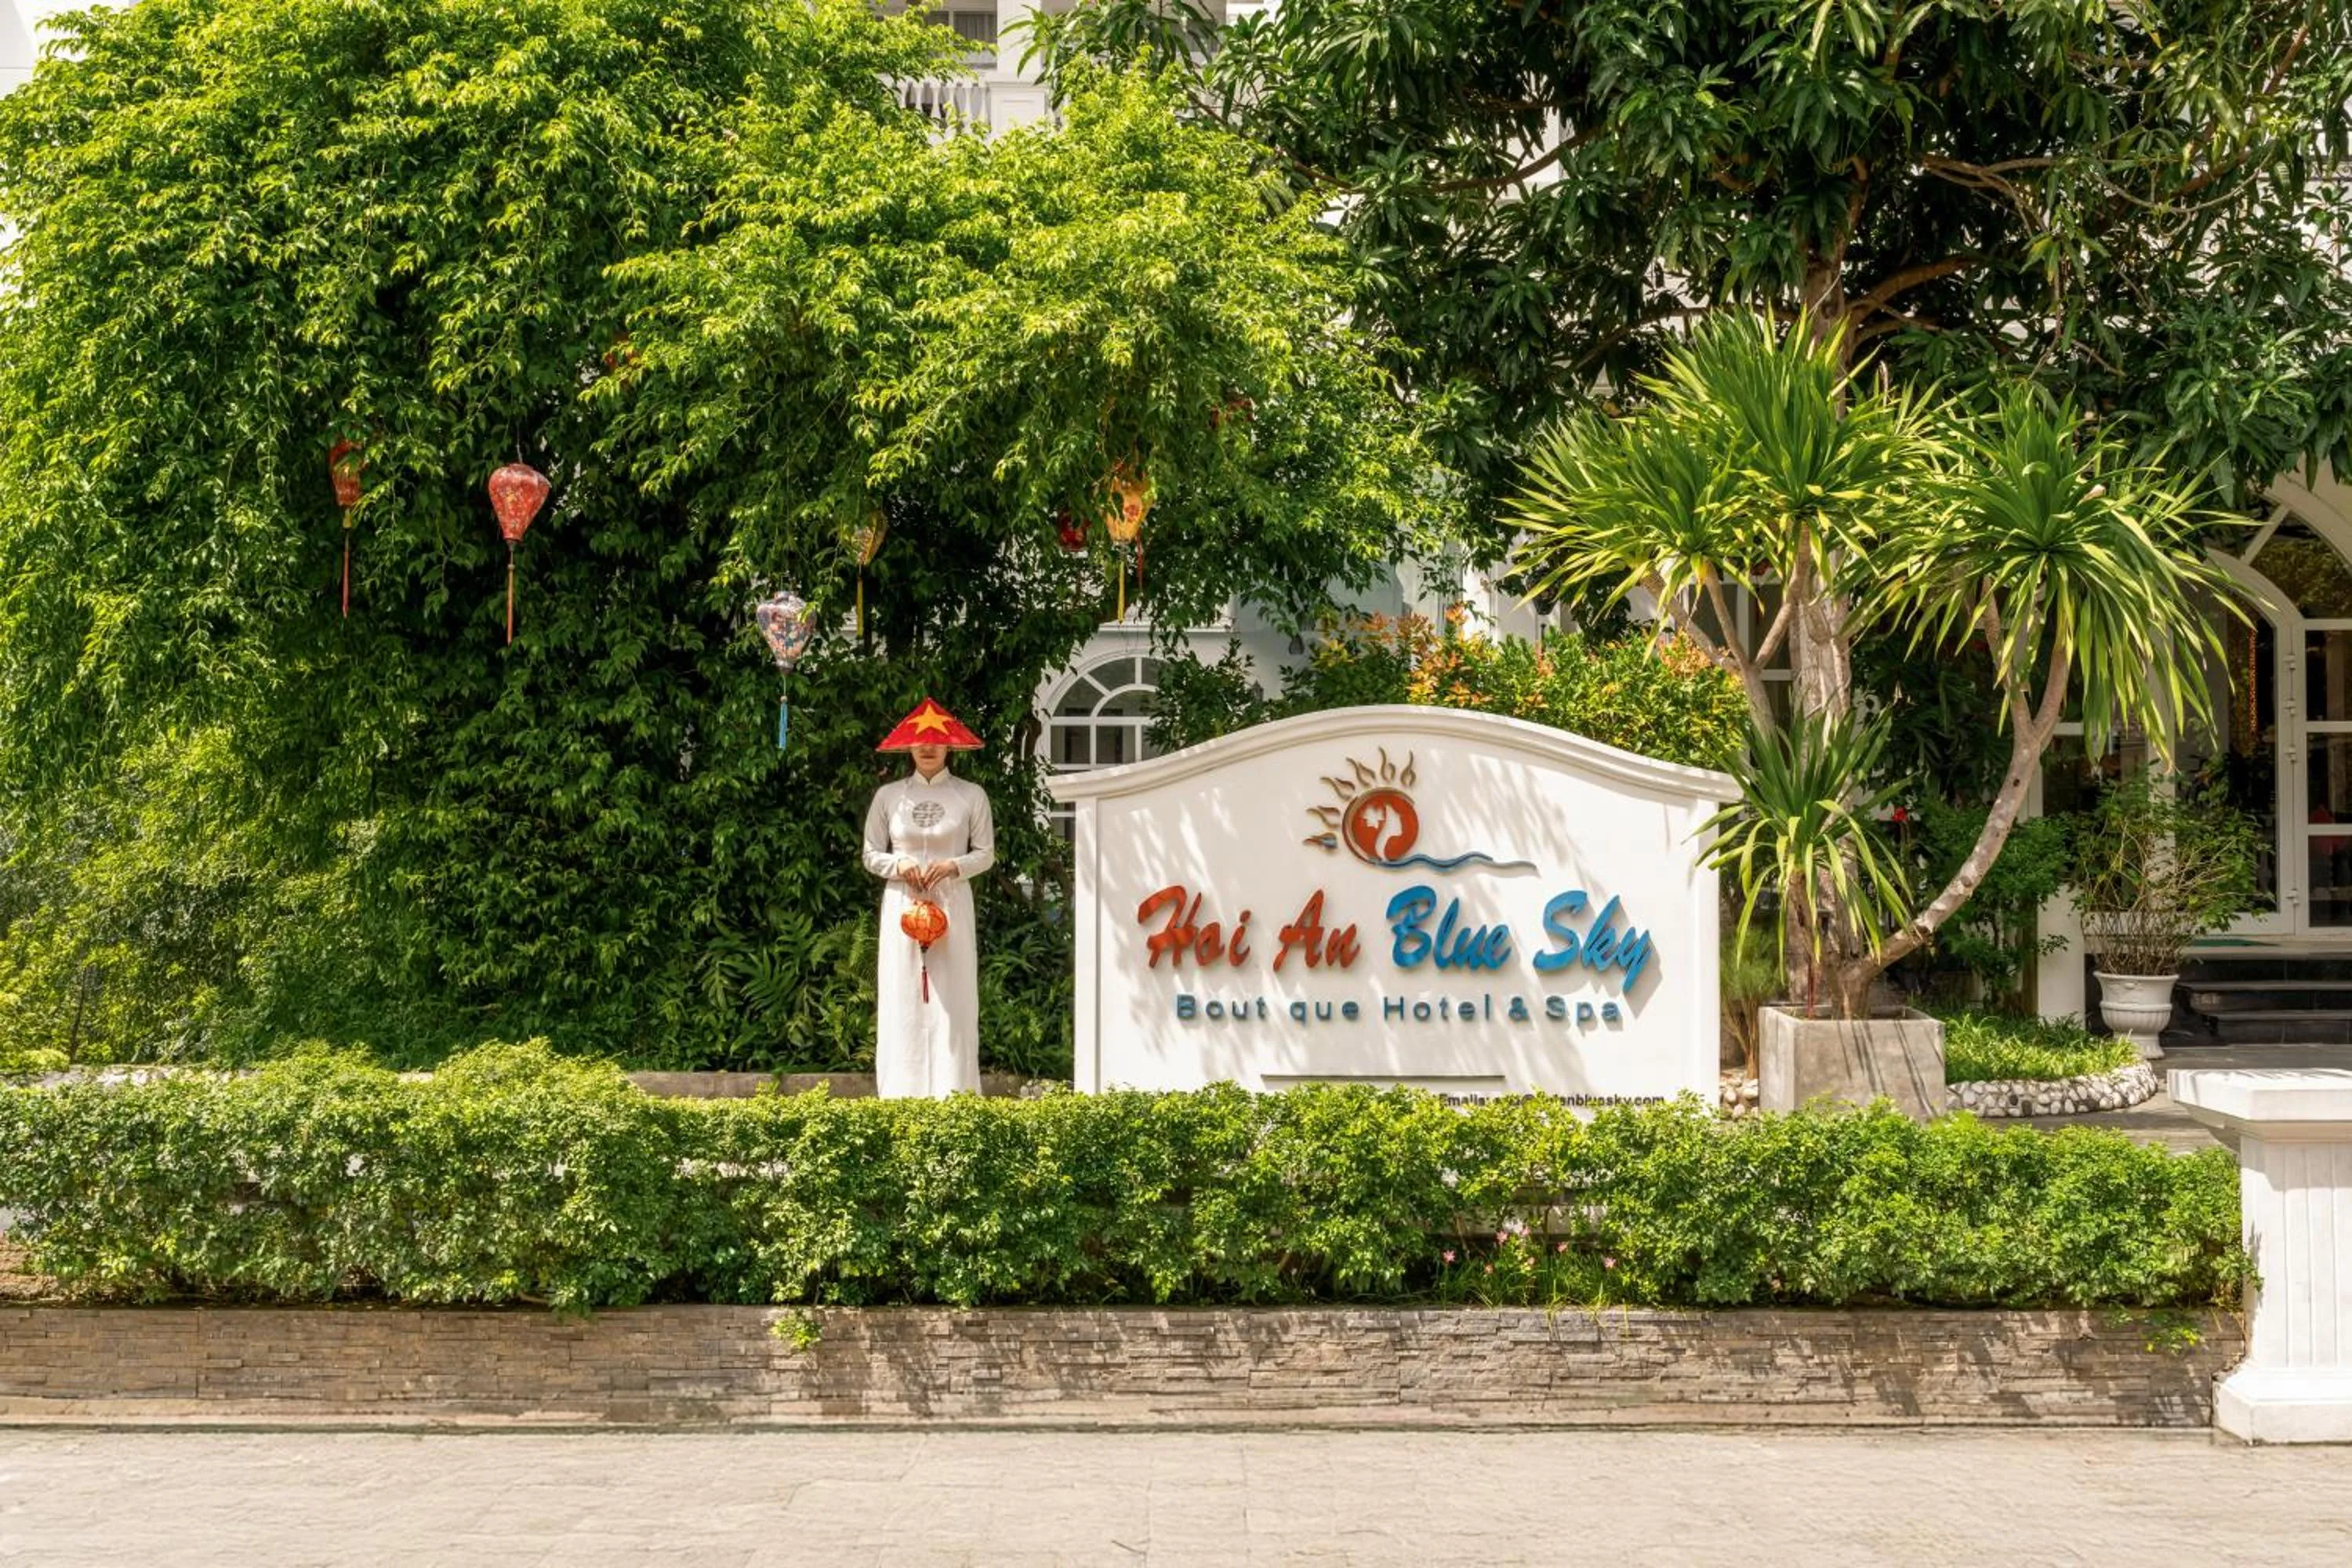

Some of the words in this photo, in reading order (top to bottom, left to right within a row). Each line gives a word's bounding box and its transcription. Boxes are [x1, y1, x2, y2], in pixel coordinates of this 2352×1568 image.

[1272, 888, 1361, 973] An
[1385, 884, 1513, 971] Blue
[1532, 889, 1652, 994] Sky
[1383, 993, 1491, 1020] Hotel
[1508, 996, 1528, 1022] &
[1544, 995, 1621, 1025] Spa
